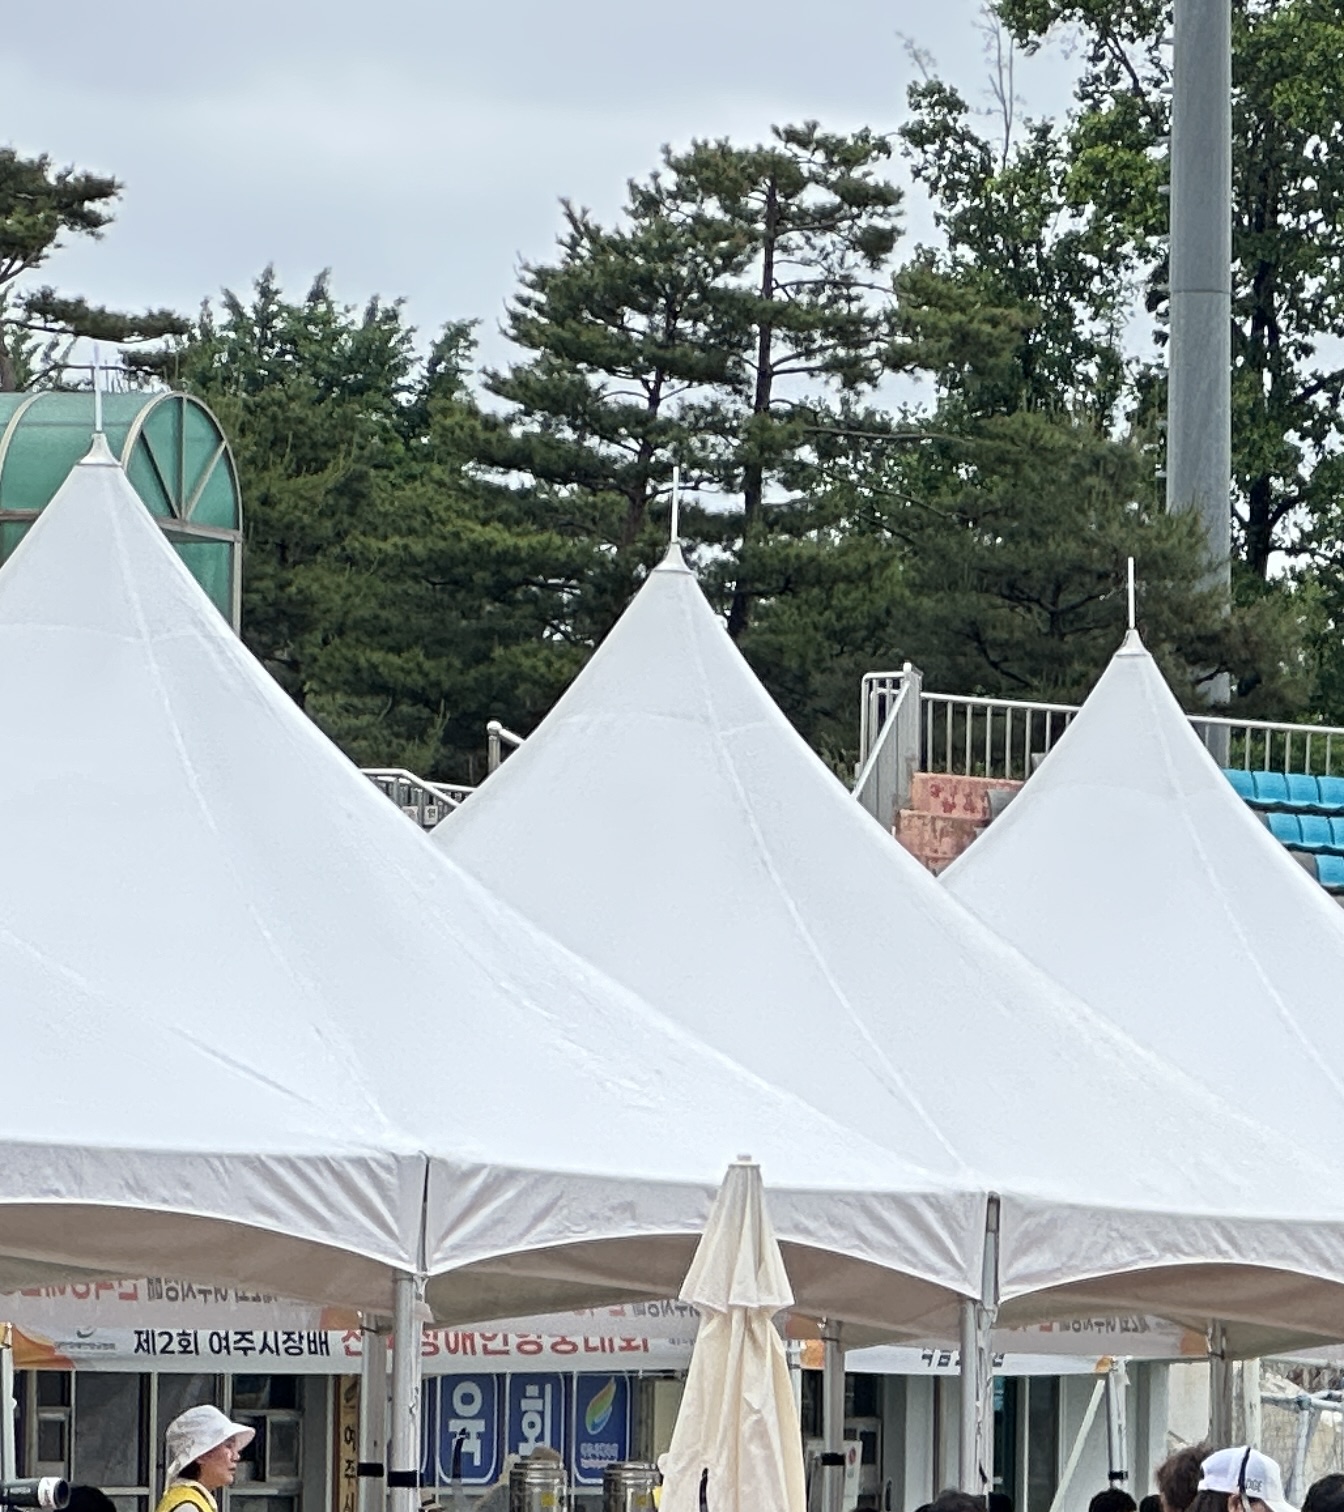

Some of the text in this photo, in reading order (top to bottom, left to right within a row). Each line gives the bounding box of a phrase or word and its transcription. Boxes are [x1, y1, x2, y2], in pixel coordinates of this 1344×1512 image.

[134, 1328, 200, 1356] 제2회
[208, 1328, 331, 1357] 여주시장배
[448, 1380, 552, 1467] 육 회
